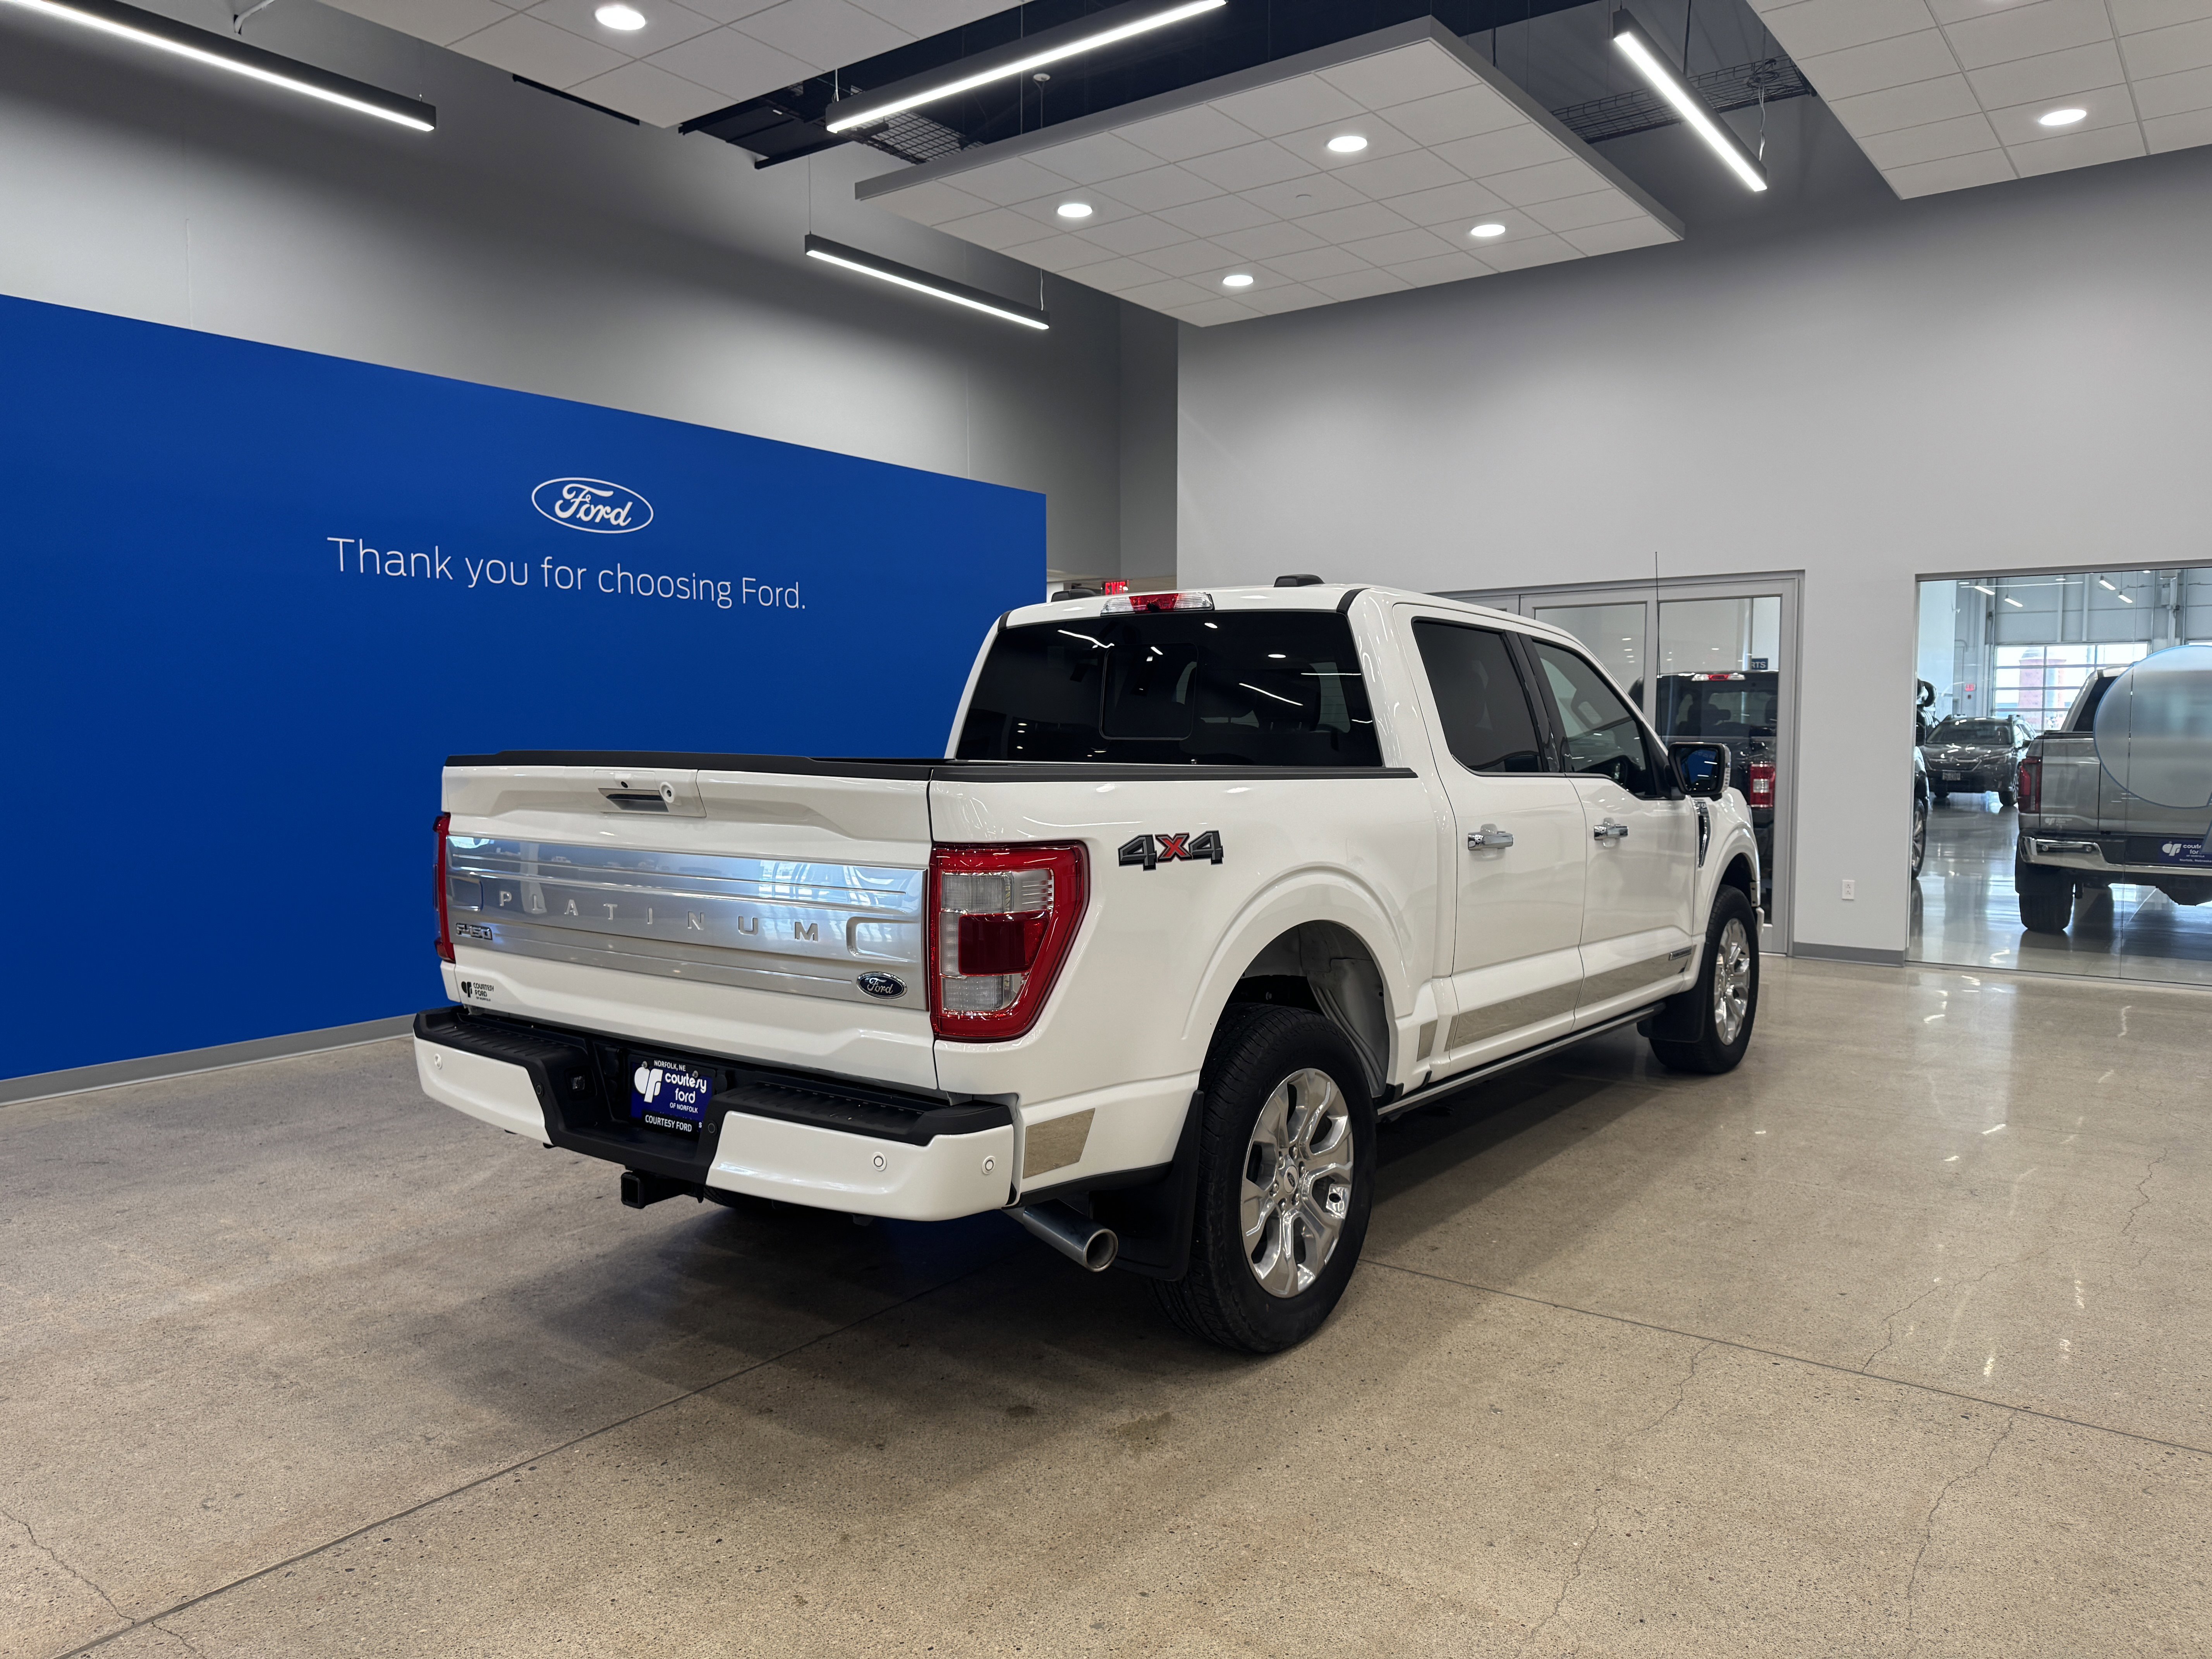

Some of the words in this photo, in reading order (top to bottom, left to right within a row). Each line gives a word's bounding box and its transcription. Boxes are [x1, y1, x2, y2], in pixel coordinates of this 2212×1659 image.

[555, 483, 633, 526] Ford
[327, 537, 453, 580] Thank
[465, 558, 528, 588] you
[541, 556, 587, 590] for
[598, 563, 732, 609] choosing
[742, 577, 805, 609] Ford.
[499, 891, 819, 942] PLATINUM
[473, 982, 494, 991] COURTESY
[867, 977, 893, 994] Ford
[654, 1060, 678, 1071] NORFOLK,
[665, 1073, 707, 1094] courtesy
[675, 1087, 696, 1104] ford
[677, 1104, 698, 1113] NORFOLK
[645, 1115, 675, 1128] COURTESY
[676, 1121, 692, 1132] FORD
